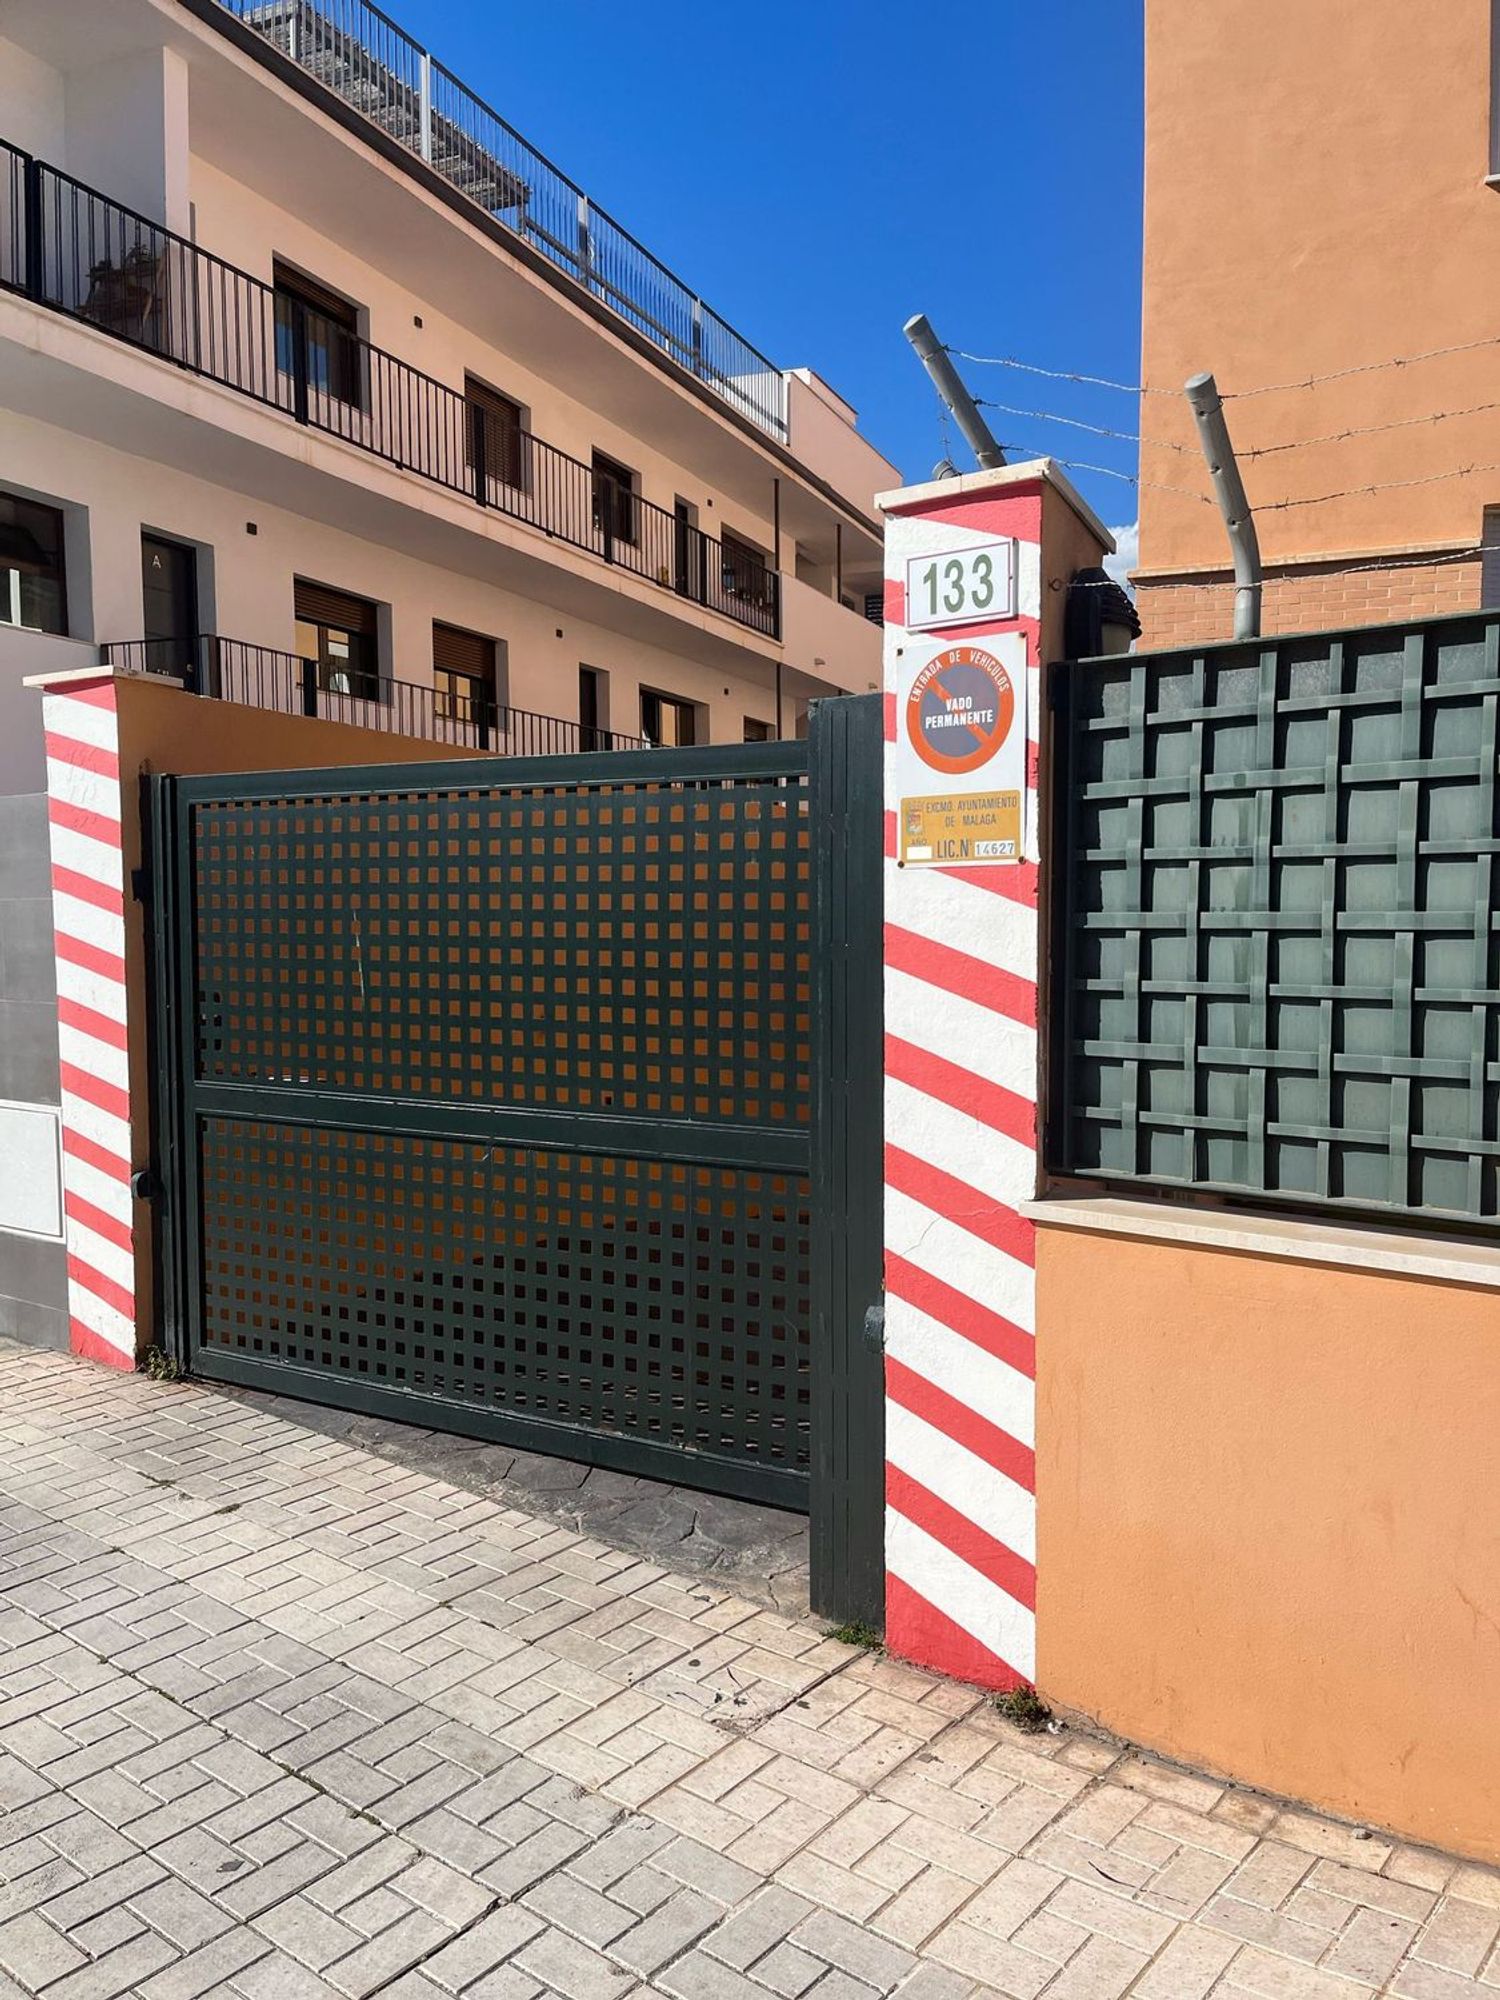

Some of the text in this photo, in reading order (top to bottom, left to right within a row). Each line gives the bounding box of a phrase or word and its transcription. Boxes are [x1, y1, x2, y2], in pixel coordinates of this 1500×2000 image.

[923, 554, 994, 615] 133
[910, 650, 1010, 703] ENTRADA DE VEHICULOS
[945, 696, 973, 711] VADO
[925, 709, 994, 729] PERMANENTE
[957, 796, 1017, 811] AYUNTAMIENTO
[945, 814, 997, 827] DE MALAGA
[976, 842, 1015, 855] 14627
